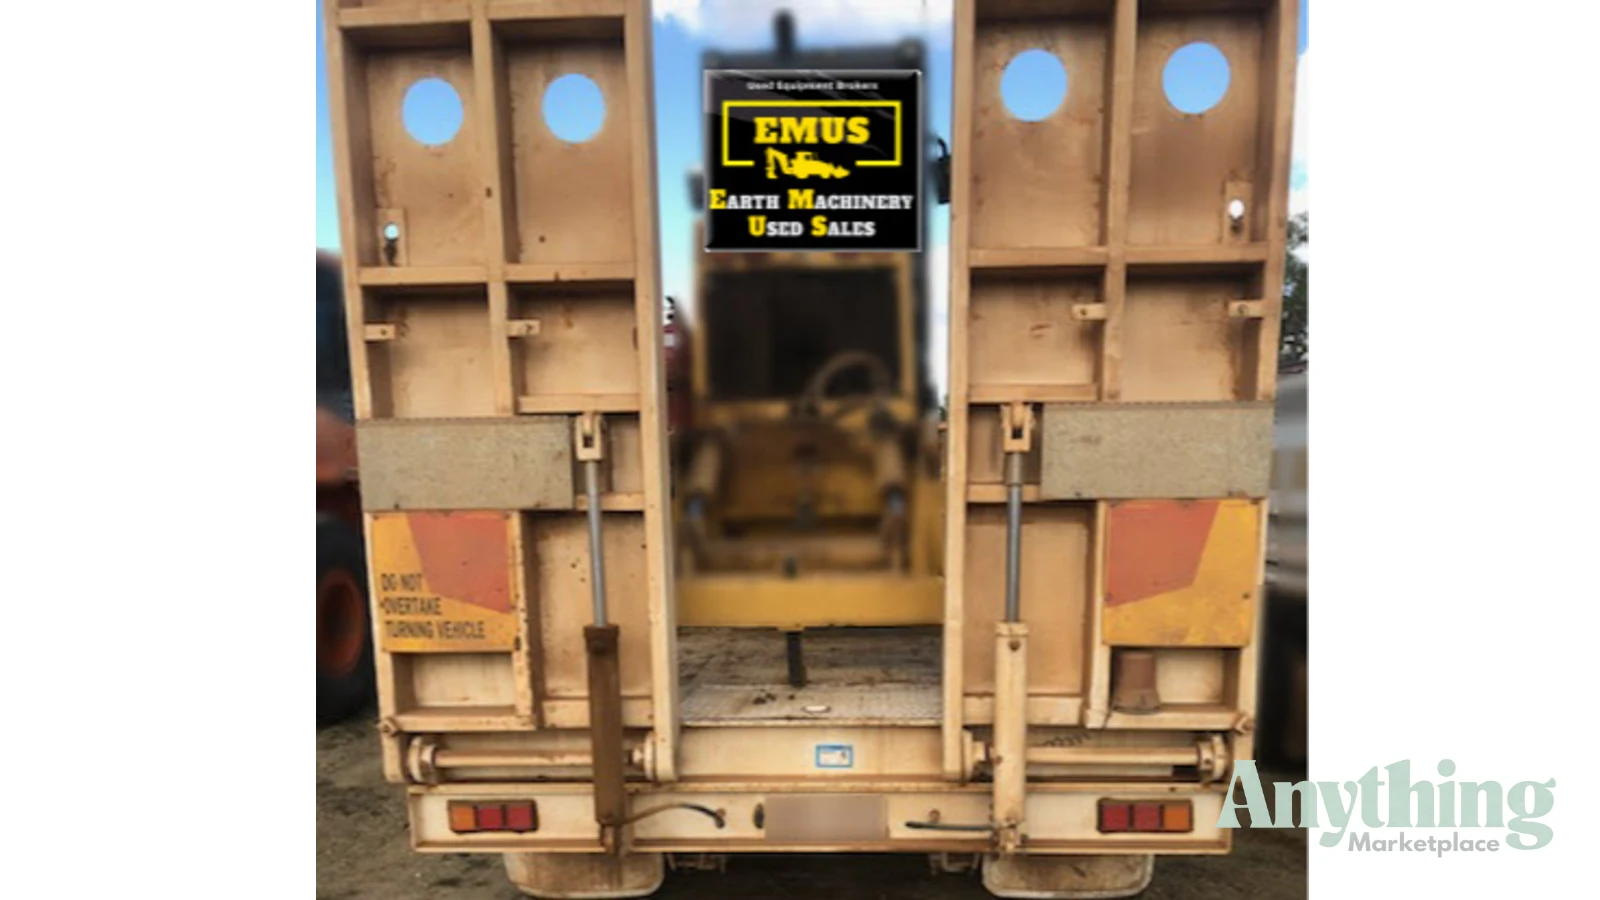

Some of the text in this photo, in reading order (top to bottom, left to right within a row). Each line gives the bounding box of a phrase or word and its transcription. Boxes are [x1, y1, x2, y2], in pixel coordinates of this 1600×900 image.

[381, 573, 422, 591] DO NOT
[384, 597, 442, 615] OVERTAKE
[385, 620, 486, 639] TURNING VEHICLE
